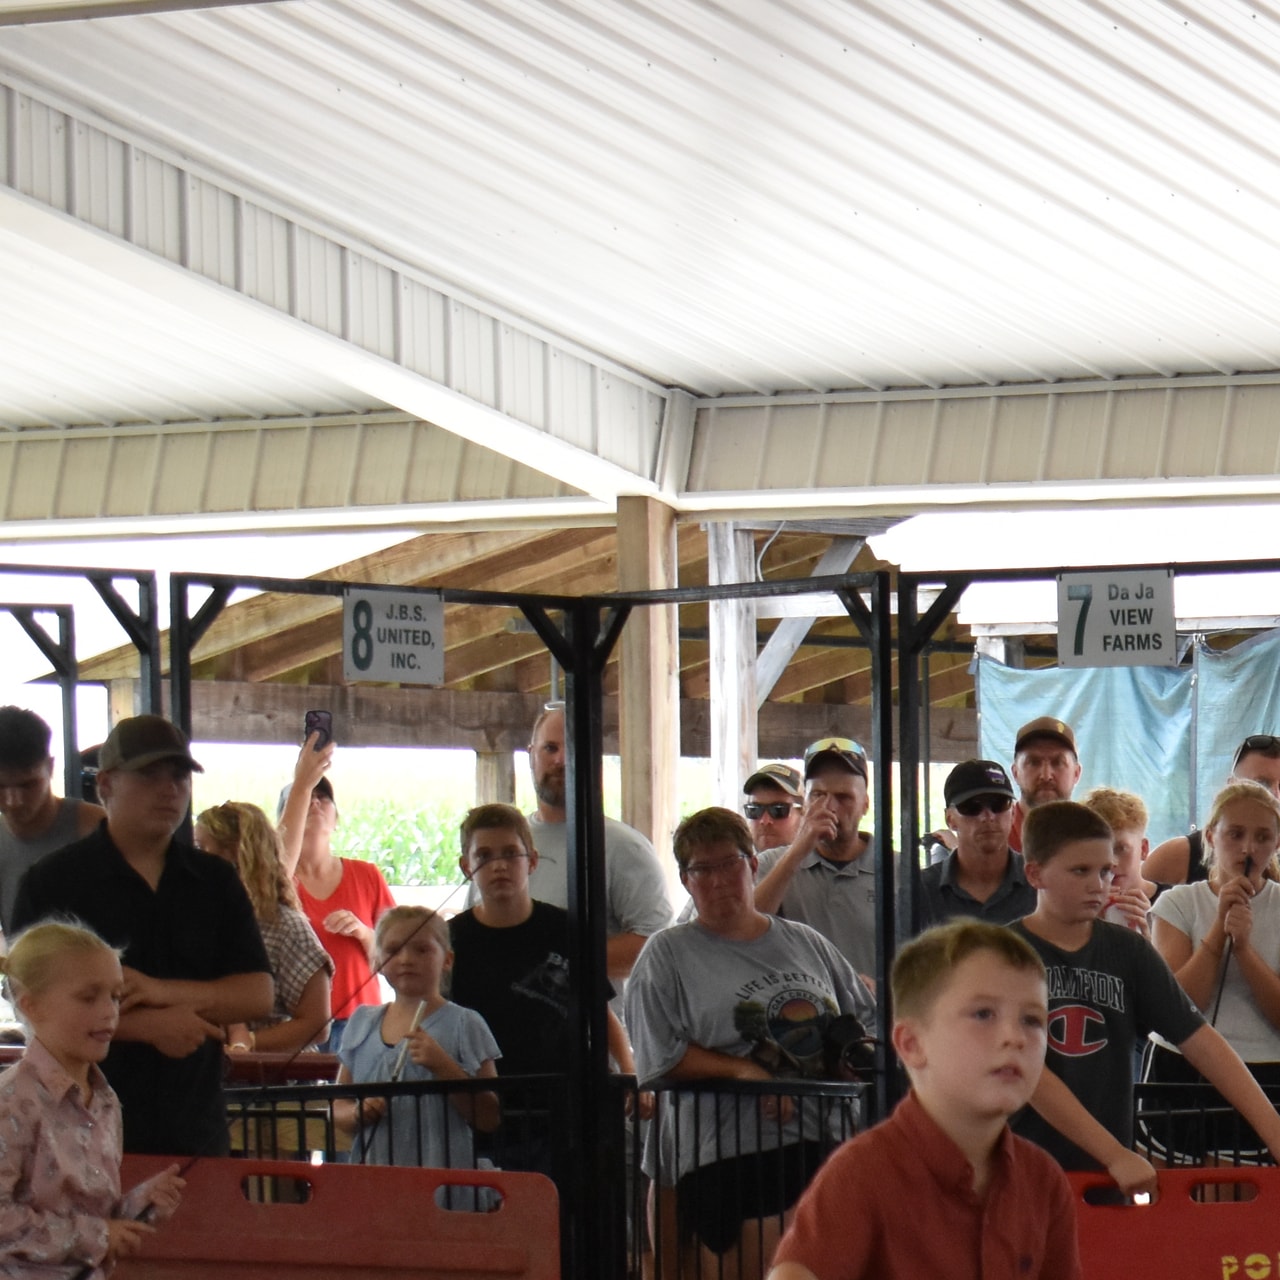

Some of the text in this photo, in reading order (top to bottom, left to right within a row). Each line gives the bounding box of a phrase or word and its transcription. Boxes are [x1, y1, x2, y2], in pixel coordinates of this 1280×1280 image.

[1108, 584, 1154, 601] Da Ja
[386, 606, 426, 621] J.B.S.
[1067, 585, 1093, 655] 7
[1111, 608, 1153, 625] VIEW
[352, 600, 373, 671] 8
[377, 628, 435, 649] UNITED,
[1103, 633, 1162, 652] FARMS
[391, 653, 420, 669] INC.
[735, 979, 764, 1001] LIFE
[762, 973, 780, 987] IS
[1046, 966, 1125, 1013] AMPION
